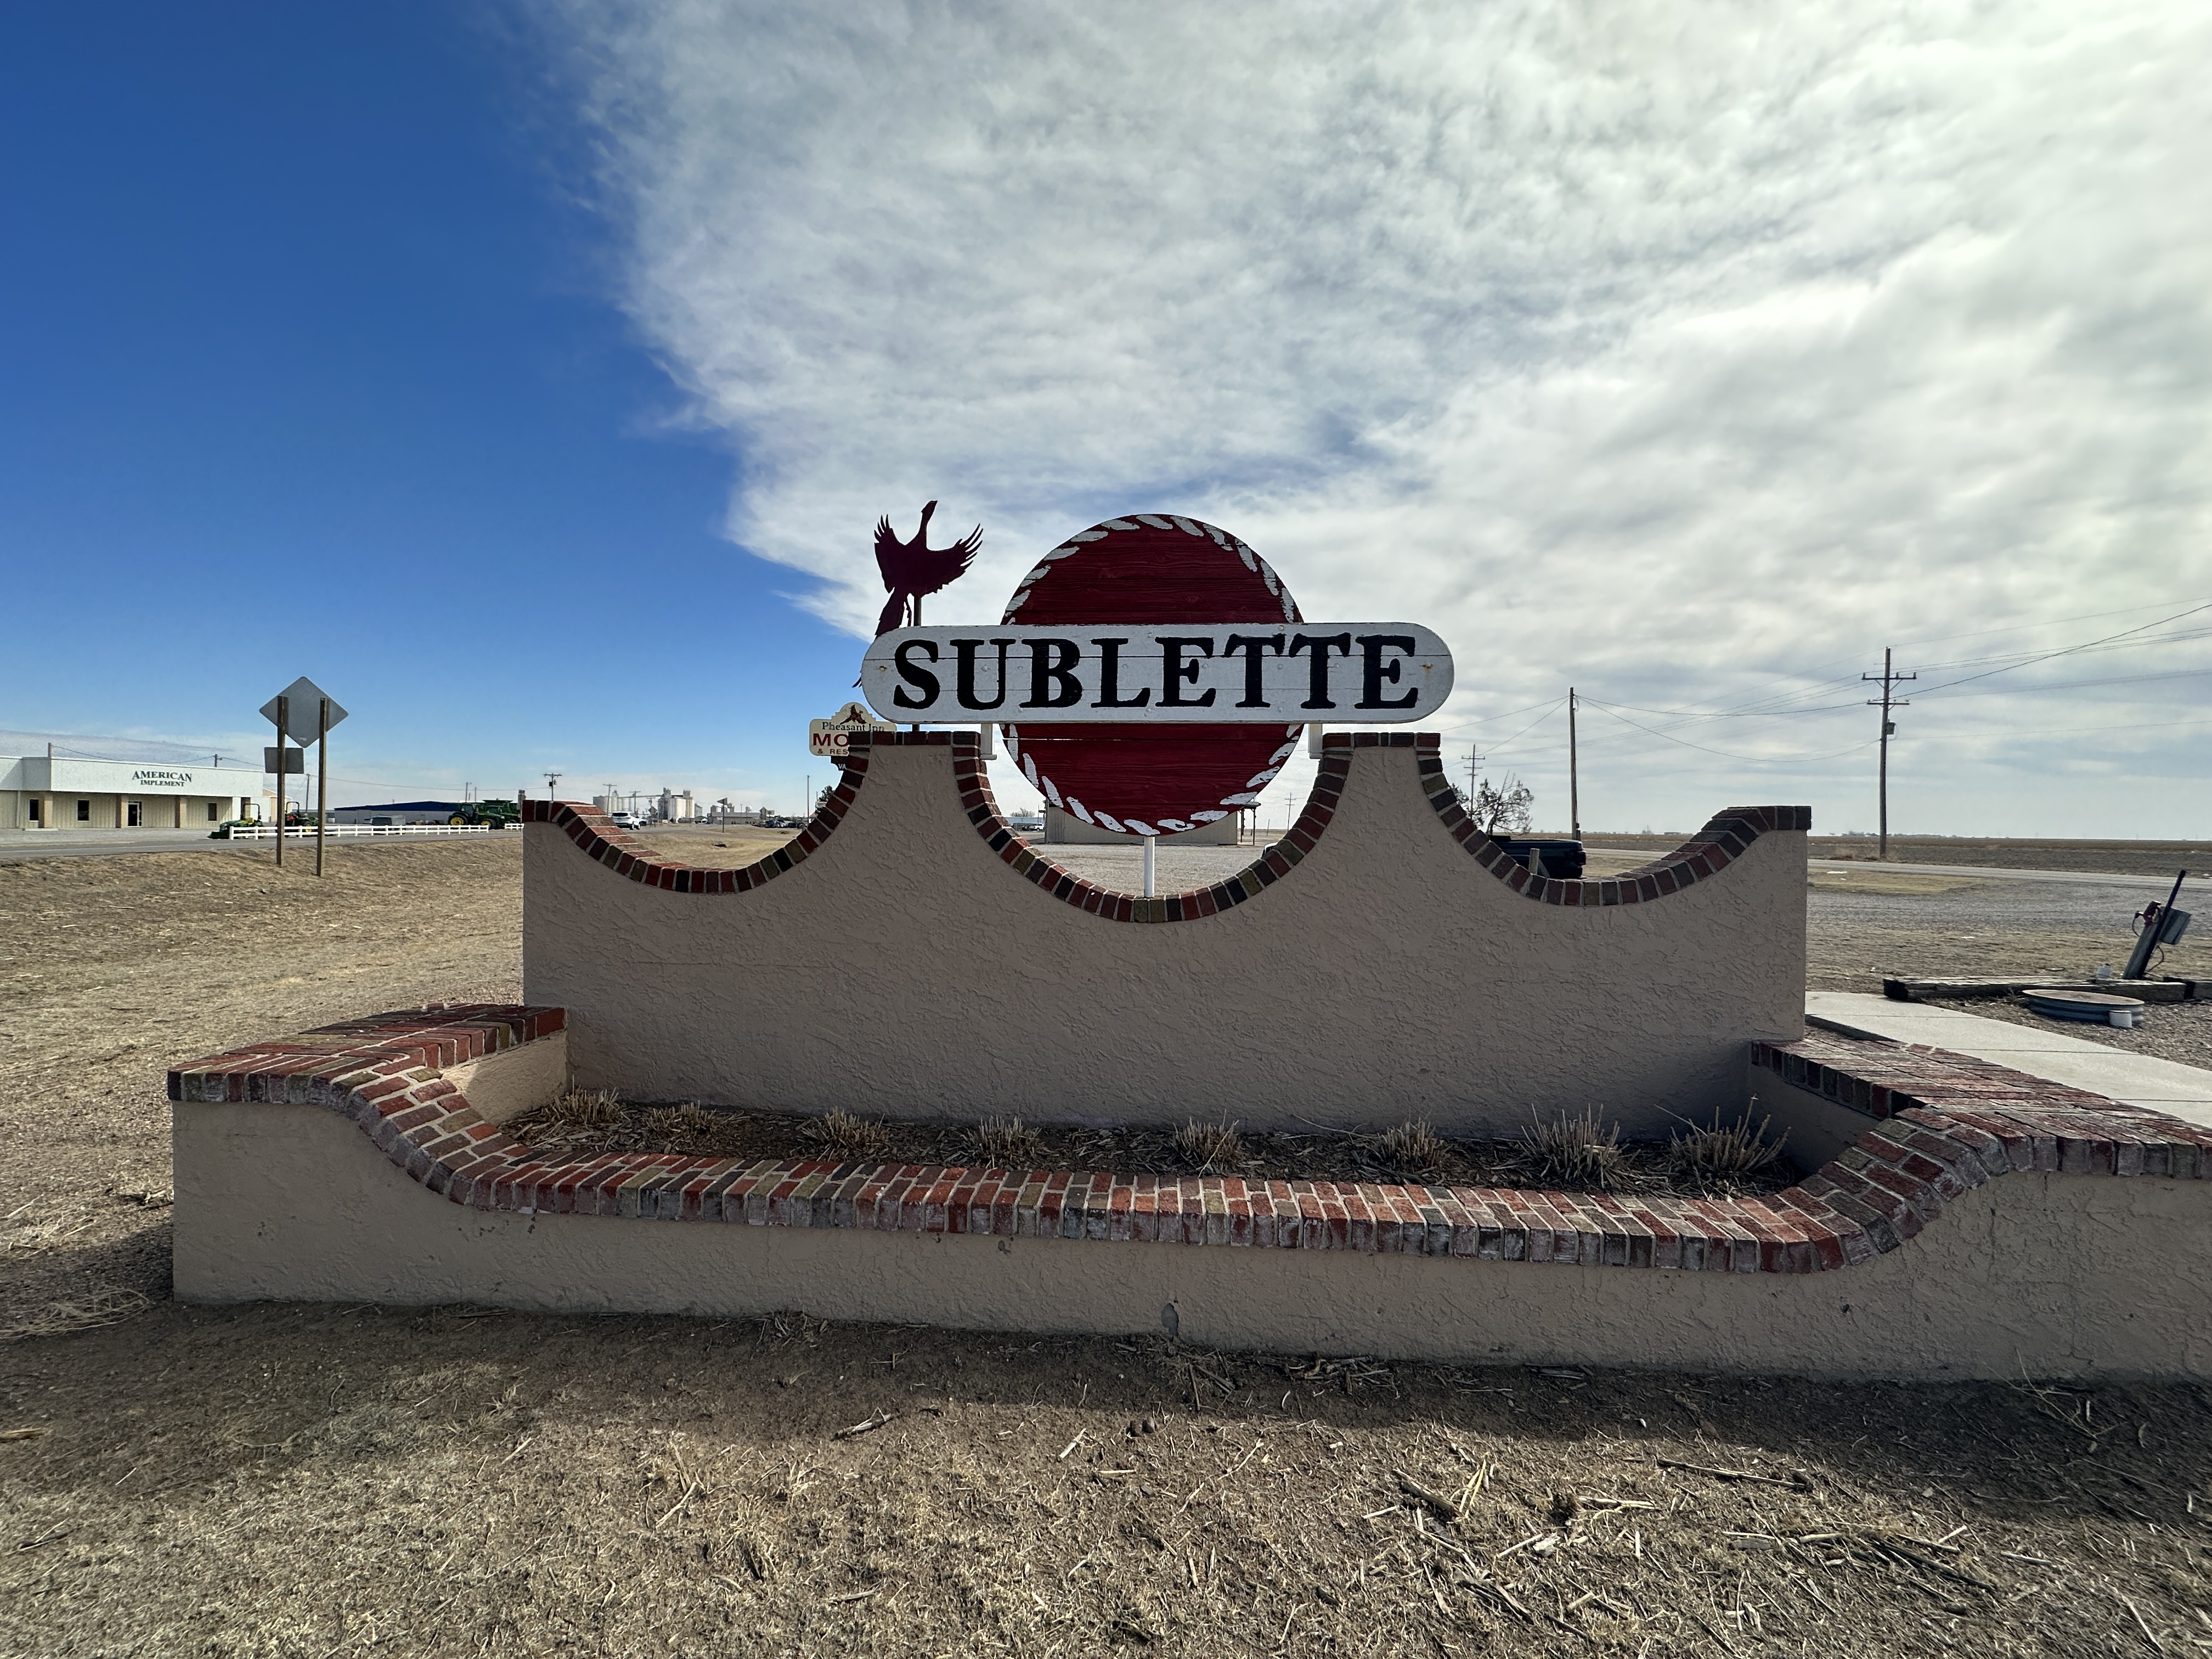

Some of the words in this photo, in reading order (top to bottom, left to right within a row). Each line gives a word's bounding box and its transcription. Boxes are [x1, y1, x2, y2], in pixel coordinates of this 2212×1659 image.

[893, 634, 1418, 710] SUBLETTE
[822, 721, 865, 731] Pheasant
[868, 724, 884, 732] Inn
[132, 771, 192, 782] AMERICAN
